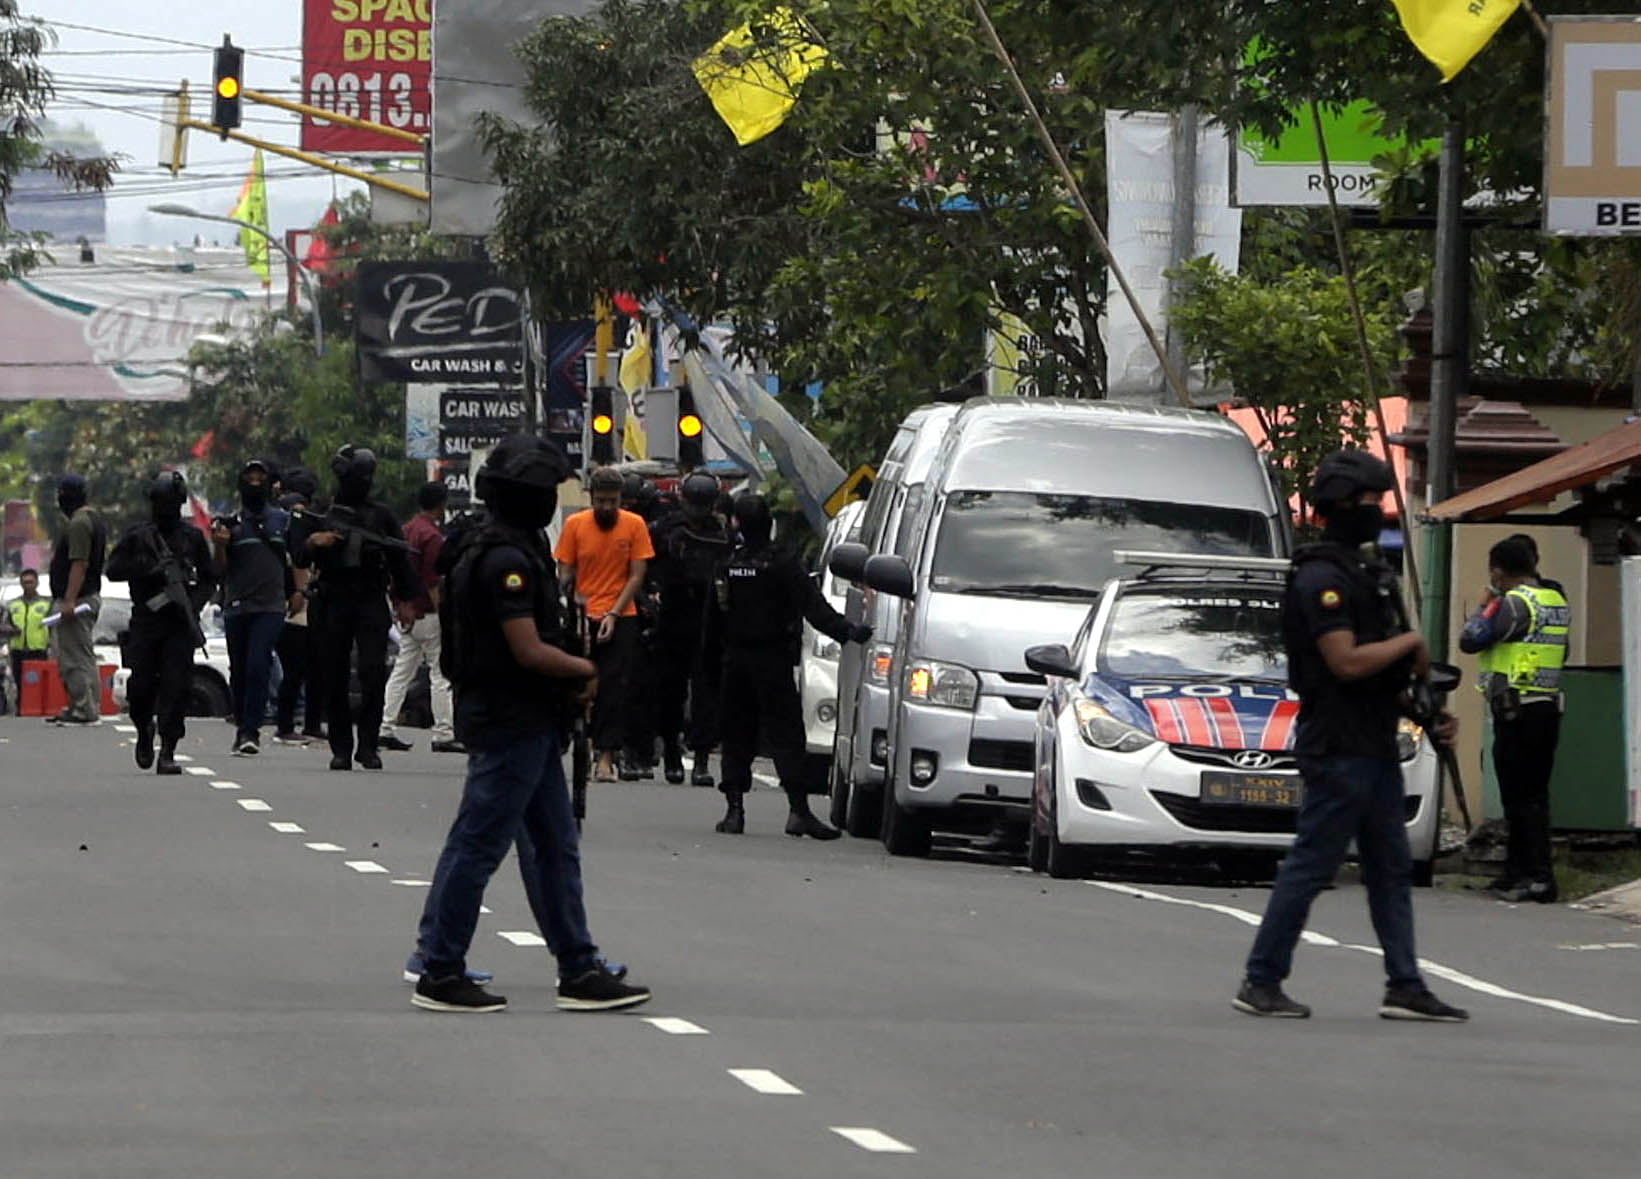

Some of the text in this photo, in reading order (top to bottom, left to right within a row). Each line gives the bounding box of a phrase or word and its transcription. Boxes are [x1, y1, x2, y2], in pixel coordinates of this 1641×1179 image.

[310, 72, 431, 127] 0813.
[1308, 175, 1375, 191] ROOM
[1597, 203, 1641, 225] BE
[411, 360, 440, 371] CAR
[445, 360, 490, 372] WASH
[494, 360, 507, 372] &
[445, 401, 480, 417] CAR
